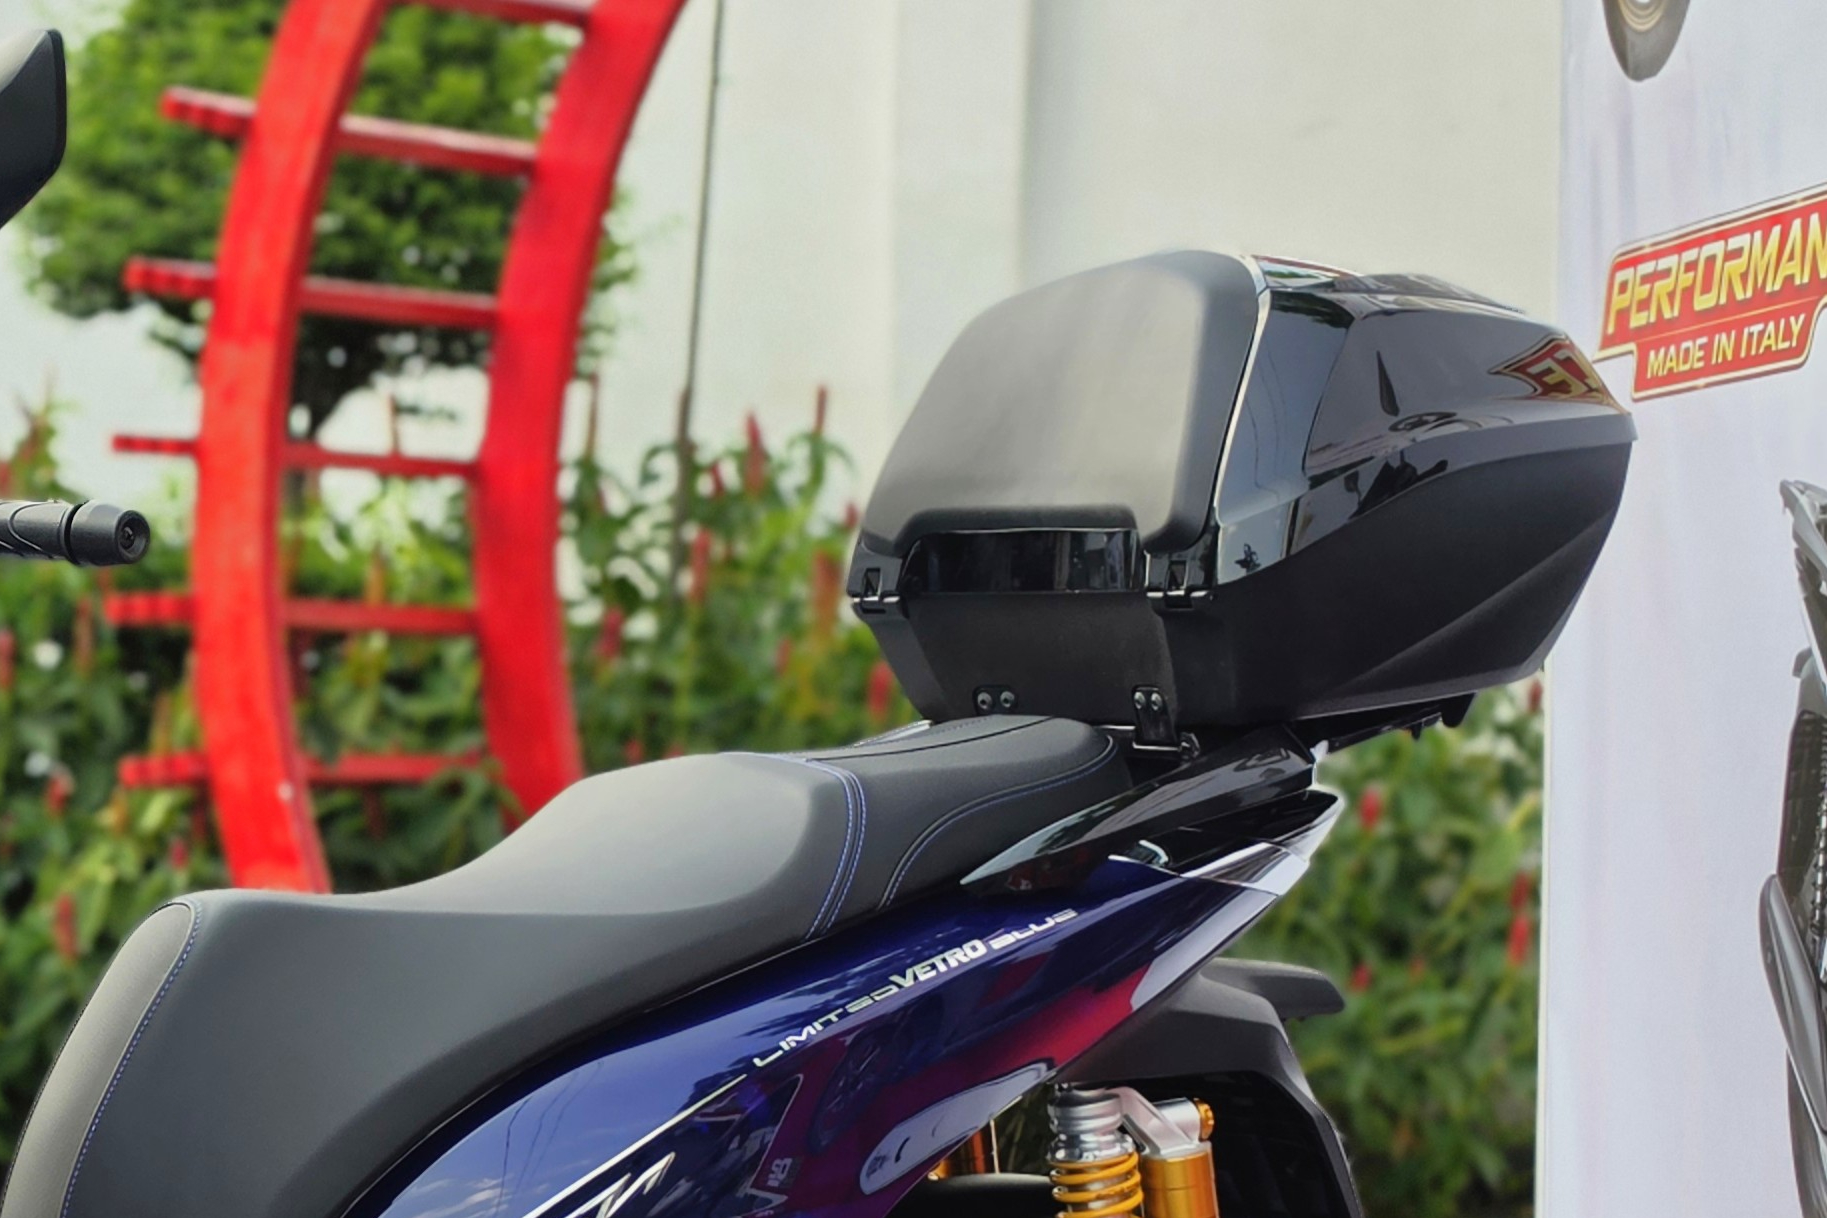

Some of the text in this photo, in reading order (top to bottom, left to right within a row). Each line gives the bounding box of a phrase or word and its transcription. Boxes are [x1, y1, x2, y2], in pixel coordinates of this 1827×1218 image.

[1647, 337, 1708, 379] MADE
[1711, 330, 1736, 365] IN
[1740, 313, 1806, 359] ITALY
[889, 939, 988, 989] VETRO
